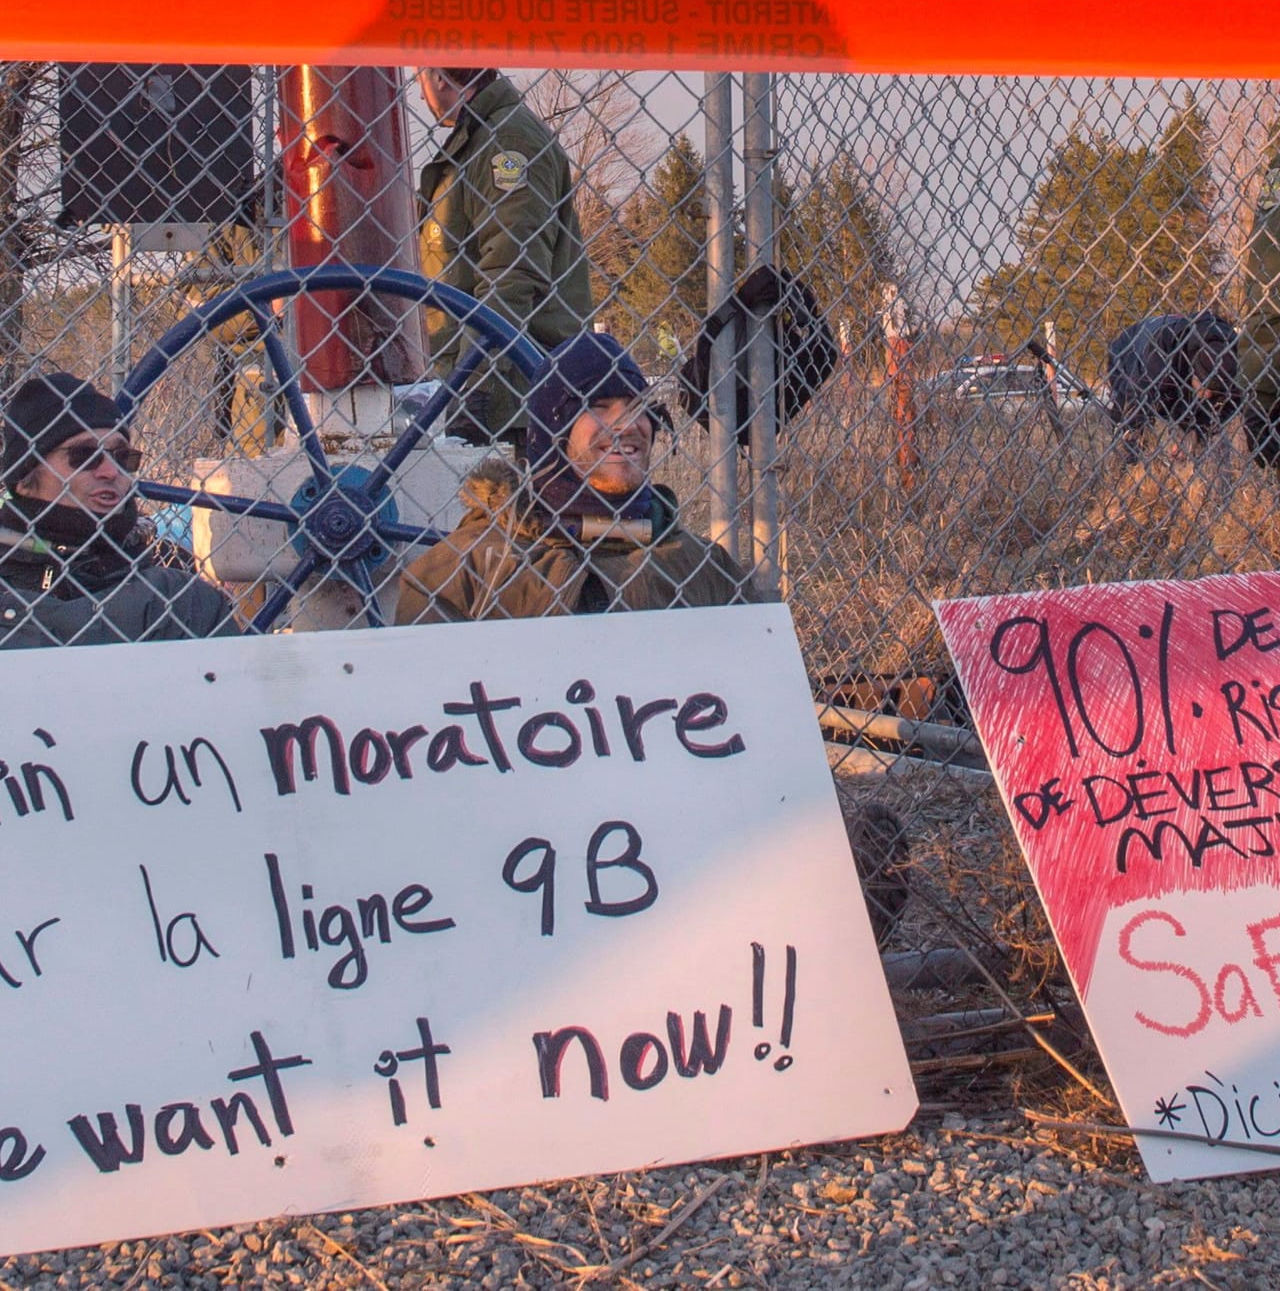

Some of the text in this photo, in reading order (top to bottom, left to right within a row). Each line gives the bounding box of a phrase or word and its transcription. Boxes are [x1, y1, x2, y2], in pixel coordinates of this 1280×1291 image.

[130, 736, 243, 813] un
[259, 678, 747, 796] moratoire
[1012, 777, 1076, 830] DE
[138, 863, 221, 968] la
[263, 852, 457, 990] ligne
[66, 1030, 313, 1174] want
[373, 1016, 451, 1127] it
